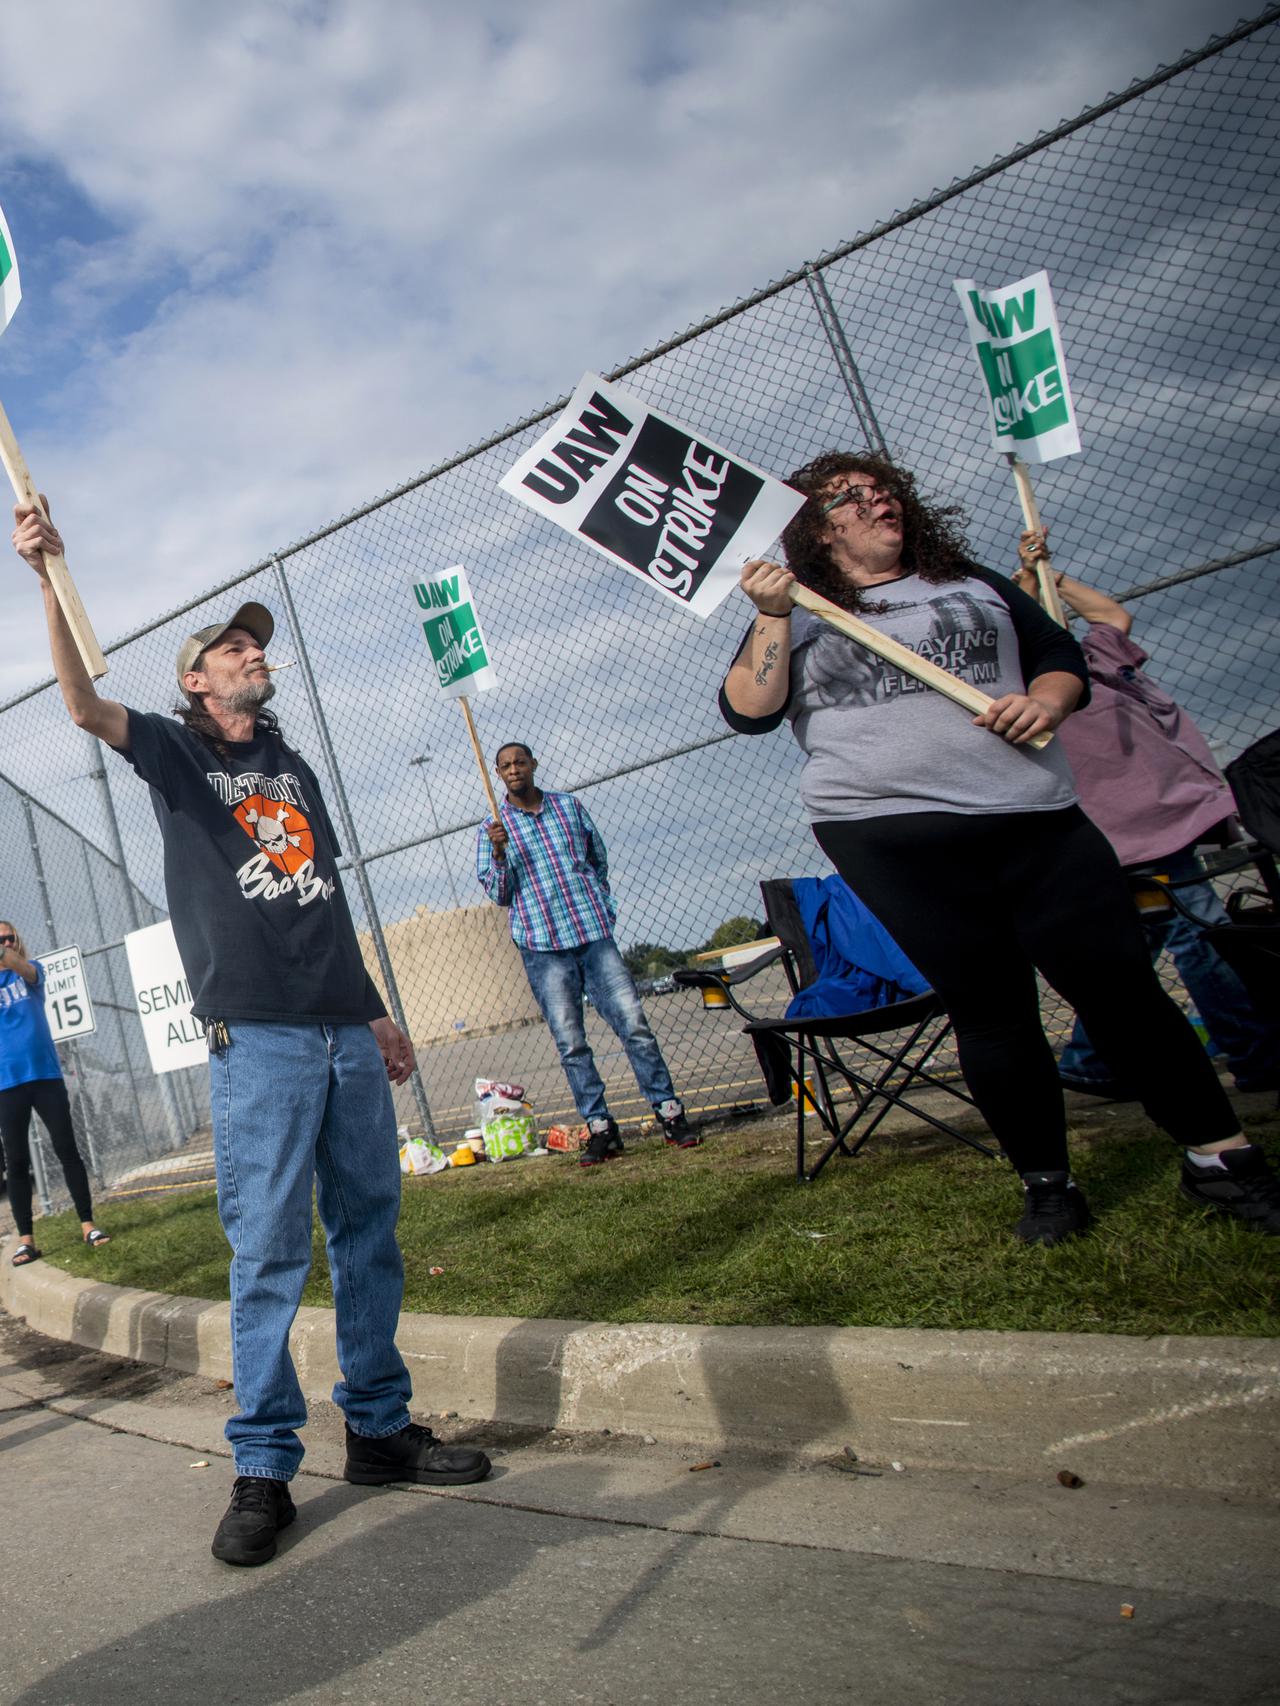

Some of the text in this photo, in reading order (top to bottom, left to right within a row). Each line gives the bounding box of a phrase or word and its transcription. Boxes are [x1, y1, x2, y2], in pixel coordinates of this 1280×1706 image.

[996, 352, 1014, 387] N
[521, 391, 634, 505] UAW
[615, 463, 669, 527] ON
[648, 440, 730, 596] STRIKE
[413, 574, 460, 609] UAW
[438, 616, 454, 647] ON
[436, 626, 482, 684] STRIKE
[929, 650, 967, 669] OR
[972, 662, 998, 683] MI
[47, 975, 76, 995] LIMIT
[138, 978, 191, 1015] SEMI
[52, 994, 83, 1030] 15
